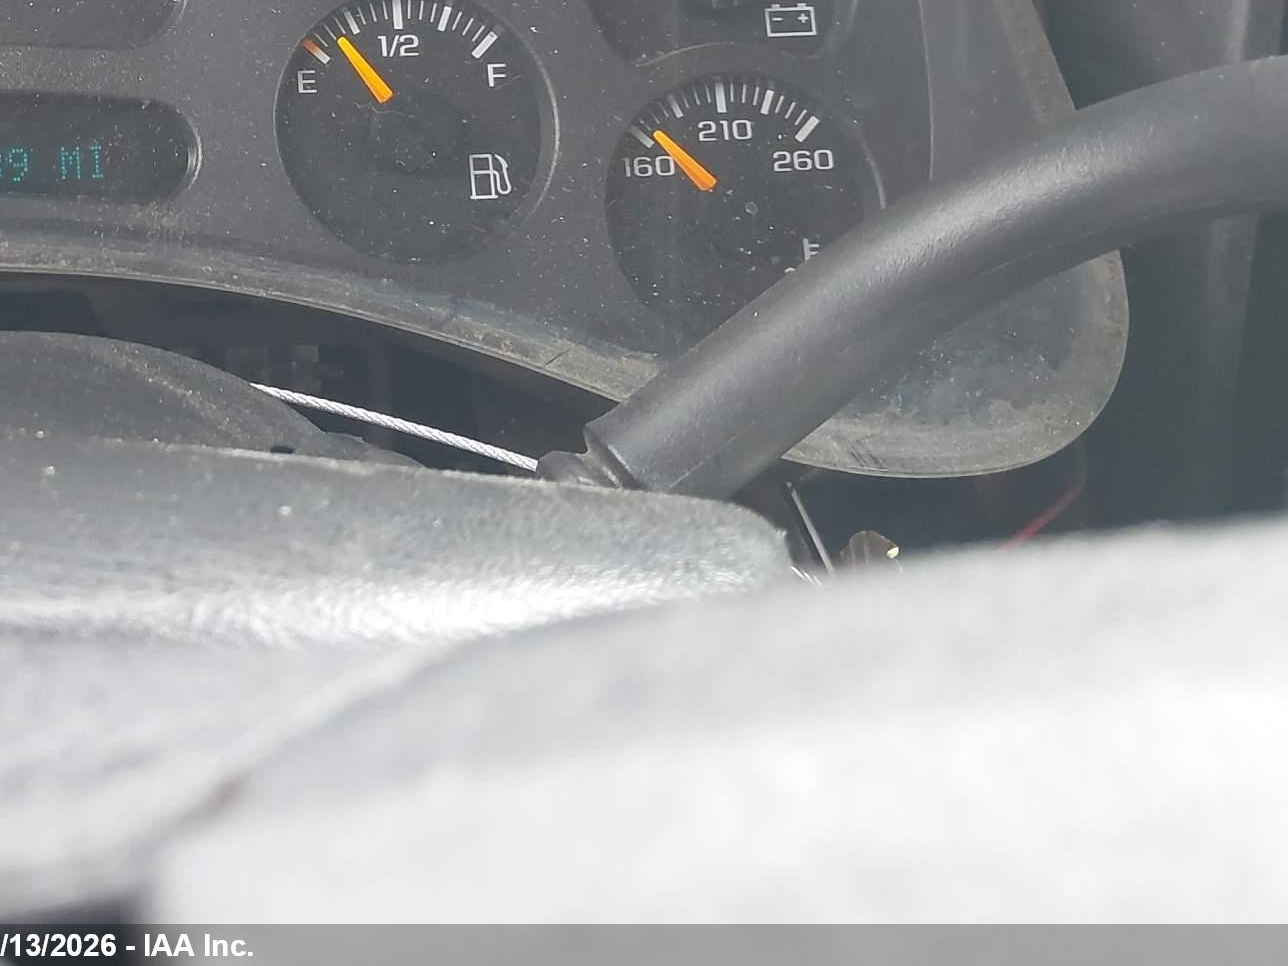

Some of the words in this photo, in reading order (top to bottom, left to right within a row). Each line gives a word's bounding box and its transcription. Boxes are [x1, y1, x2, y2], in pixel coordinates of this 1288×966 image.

[377, 34, 419, 58] 1/2
[297, 69, 318, 94] E
[487, 63, 506, 87] F
[697, 119, 753, 142] 210
[61, 144, 104, 180] MI
[623, 156, 674, 177] 160
[772, 149, 834, 172] 260
